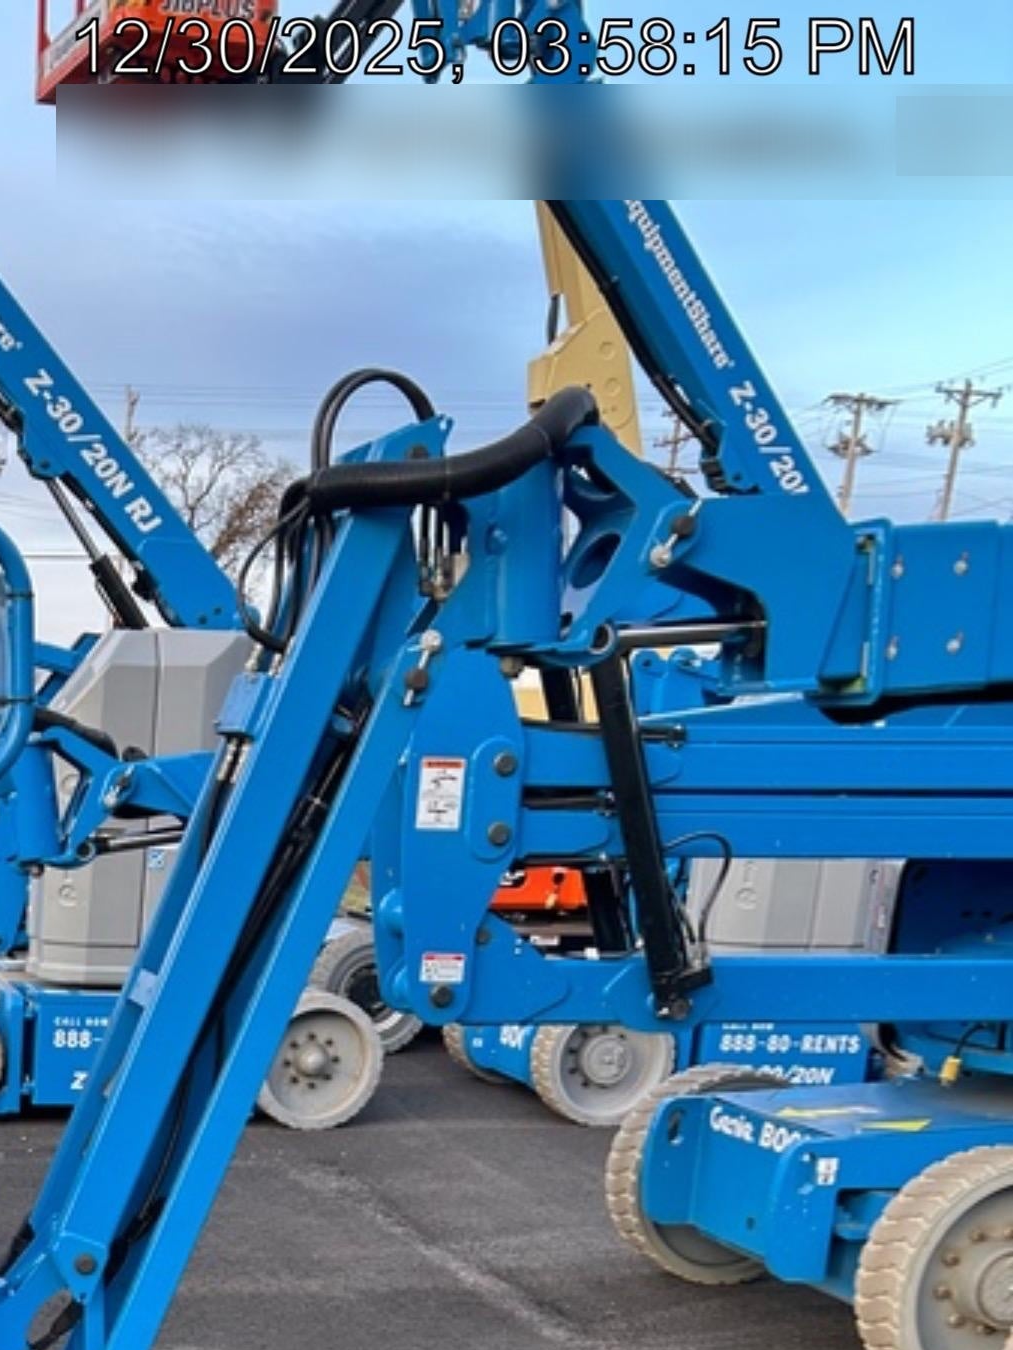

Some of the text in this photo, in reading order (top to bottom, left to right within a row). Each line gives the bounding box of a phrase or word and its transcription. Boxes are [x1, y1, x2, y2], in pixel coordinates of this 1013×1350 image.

[625, 200, 730, 370] quipmentShare
[24, 368, 163, 533] Z-30/20N RJ
[719, 1033, 861, 1054] 888-80-RENTS
[709, 1105, 755, 1143] Genie
